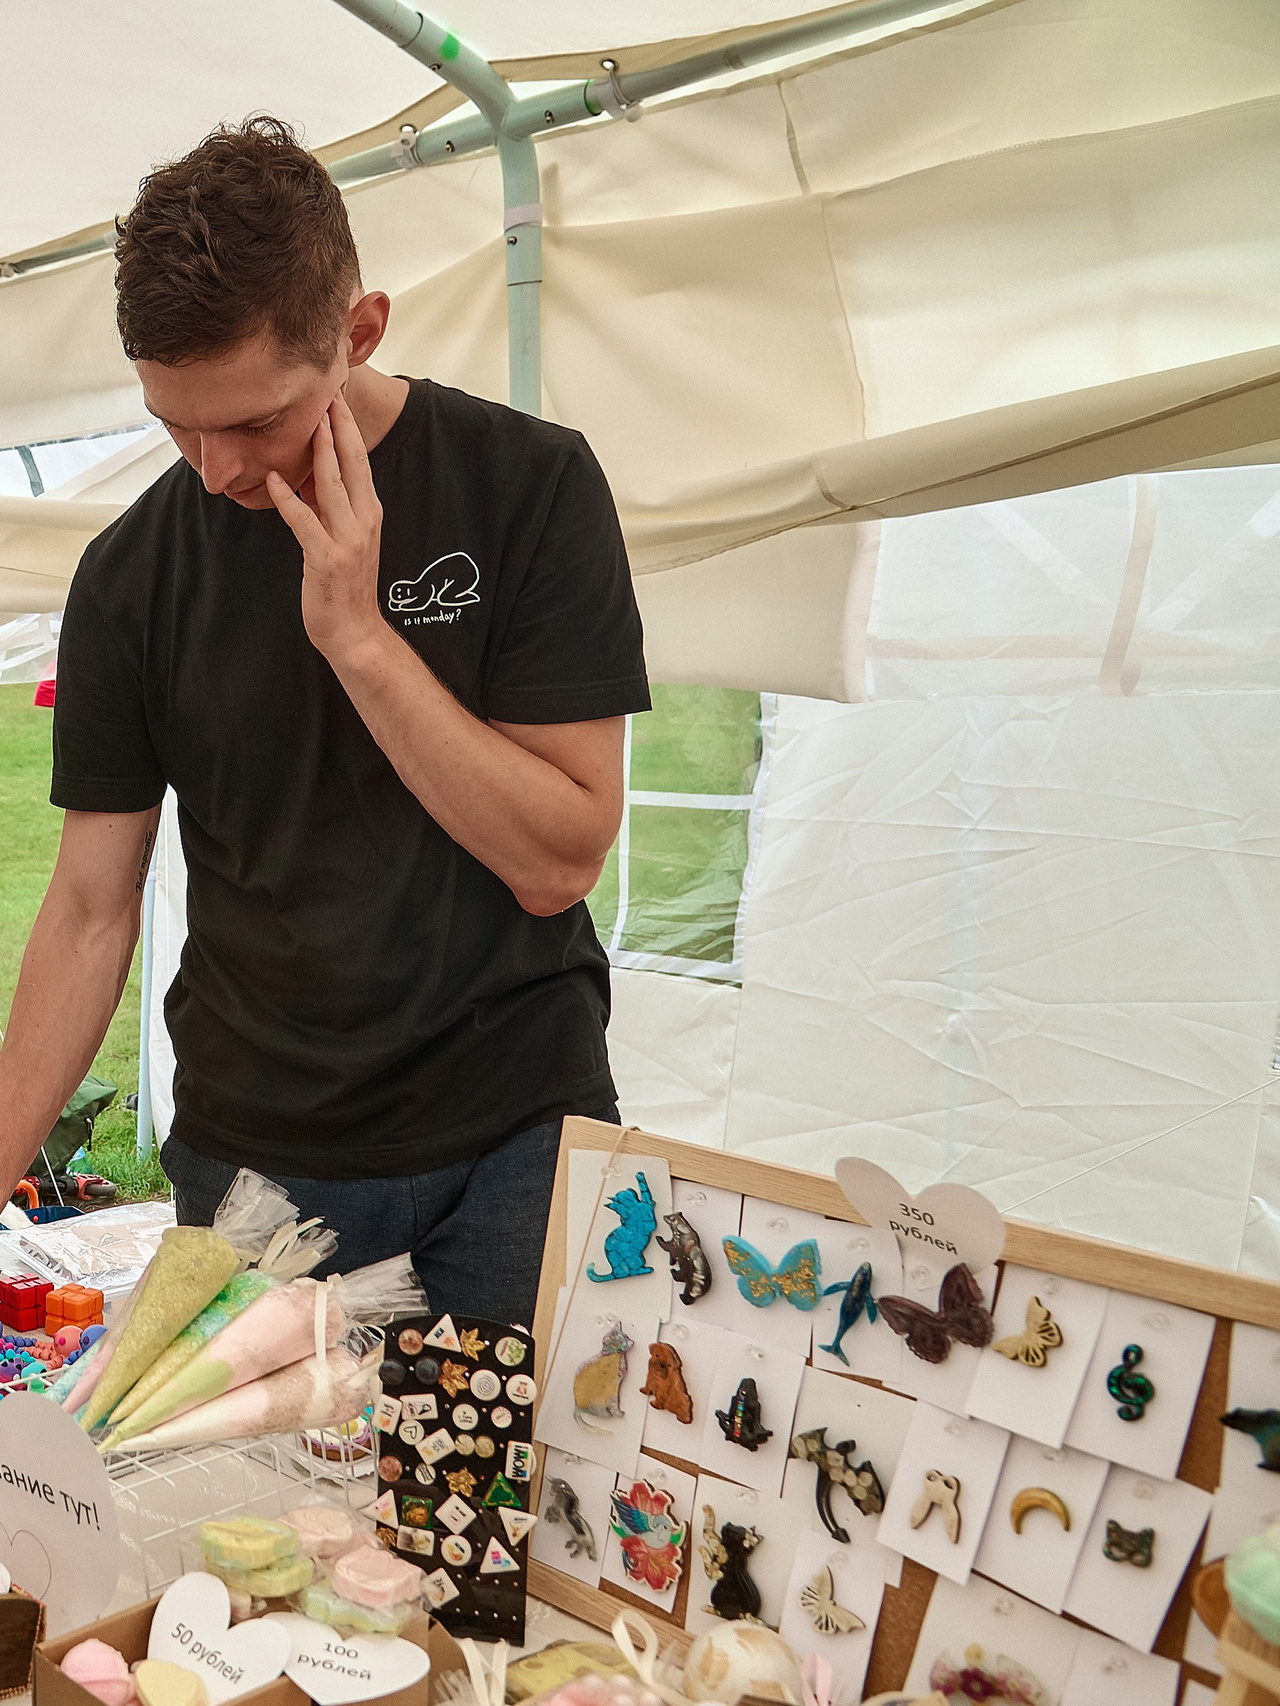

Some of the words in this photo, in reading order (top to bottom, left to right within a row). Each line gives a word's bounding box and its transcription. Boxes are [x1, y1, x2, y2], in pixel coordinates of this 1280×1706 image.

[899, 1203, 935, 1226] 350
[888, 1220, 958, 1255] рублей
[511, 1445, 529, 1478] WOW!
[59, 1490, 101, 1532] тут!
[170, 1622, 194, 1645] 50
[190, 1638, 246, 1685] рублей
[297, 1652, 372, 1680] рублей
[322, 1641, 360, 1659] 100
